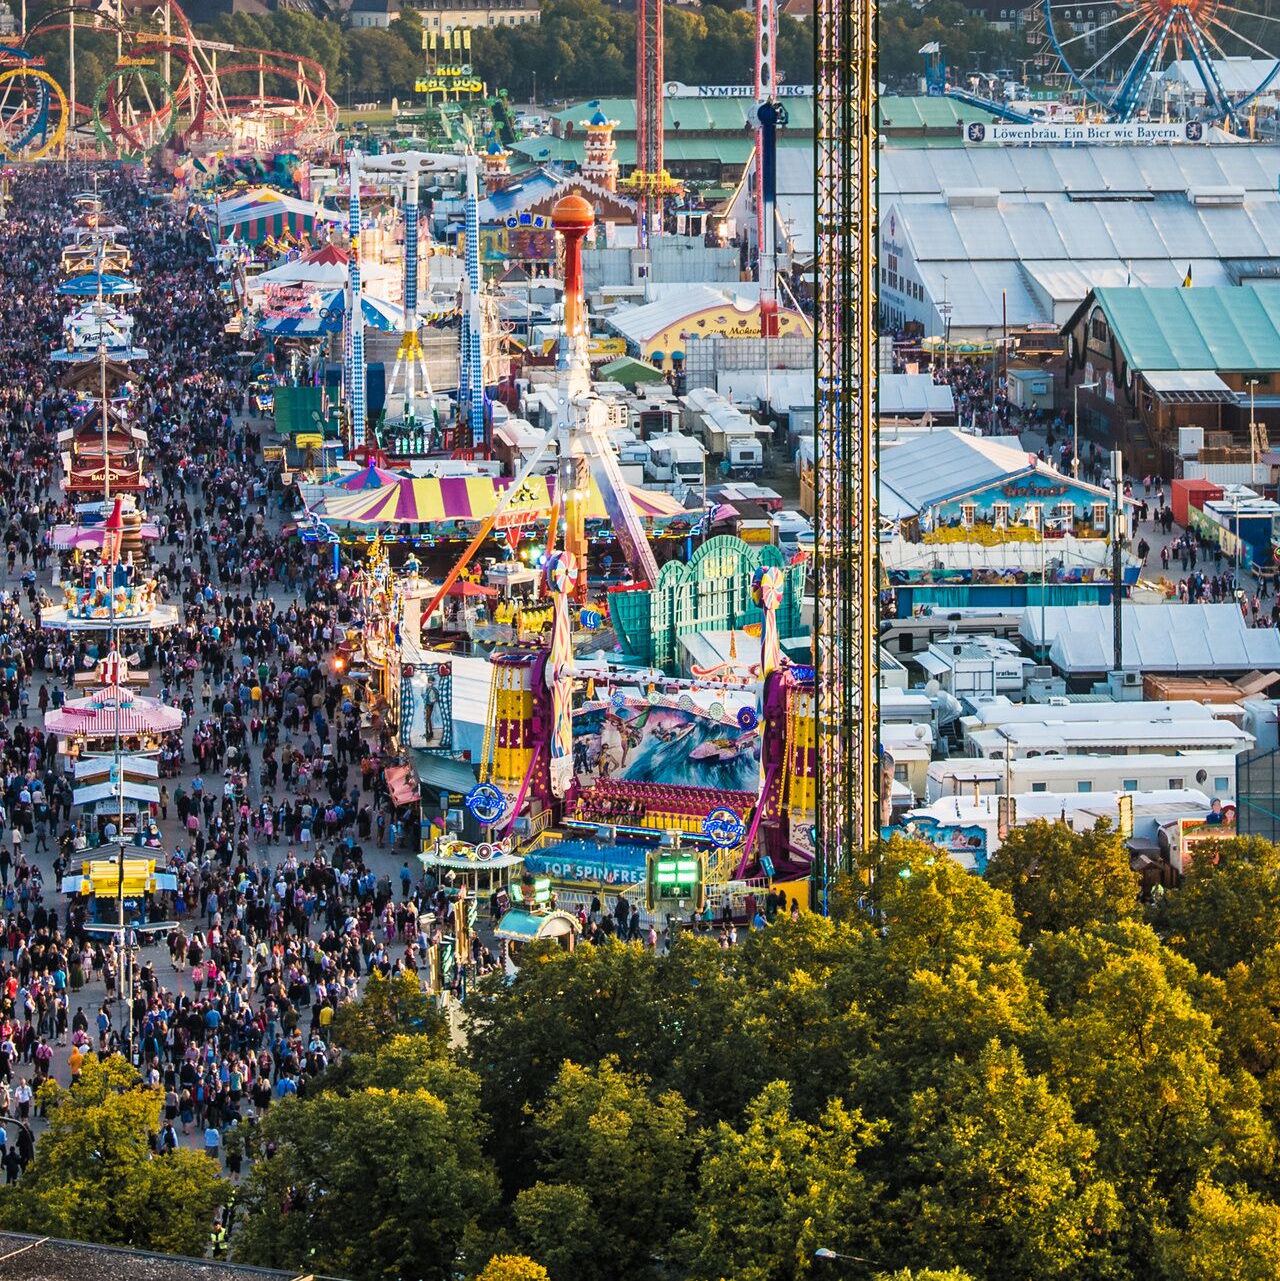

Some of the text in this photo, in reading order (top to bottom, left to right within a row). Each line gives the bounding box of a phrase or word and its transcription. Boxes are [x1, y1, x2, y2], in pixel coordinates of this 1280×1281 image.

[698, 86, 804, 96] NYMPHEURG
[993, 126, 1180, 140] Löwenbräu. Ein Bier wie Bayern.
[544, 860, 647, 884] TOP SPIN FRES
